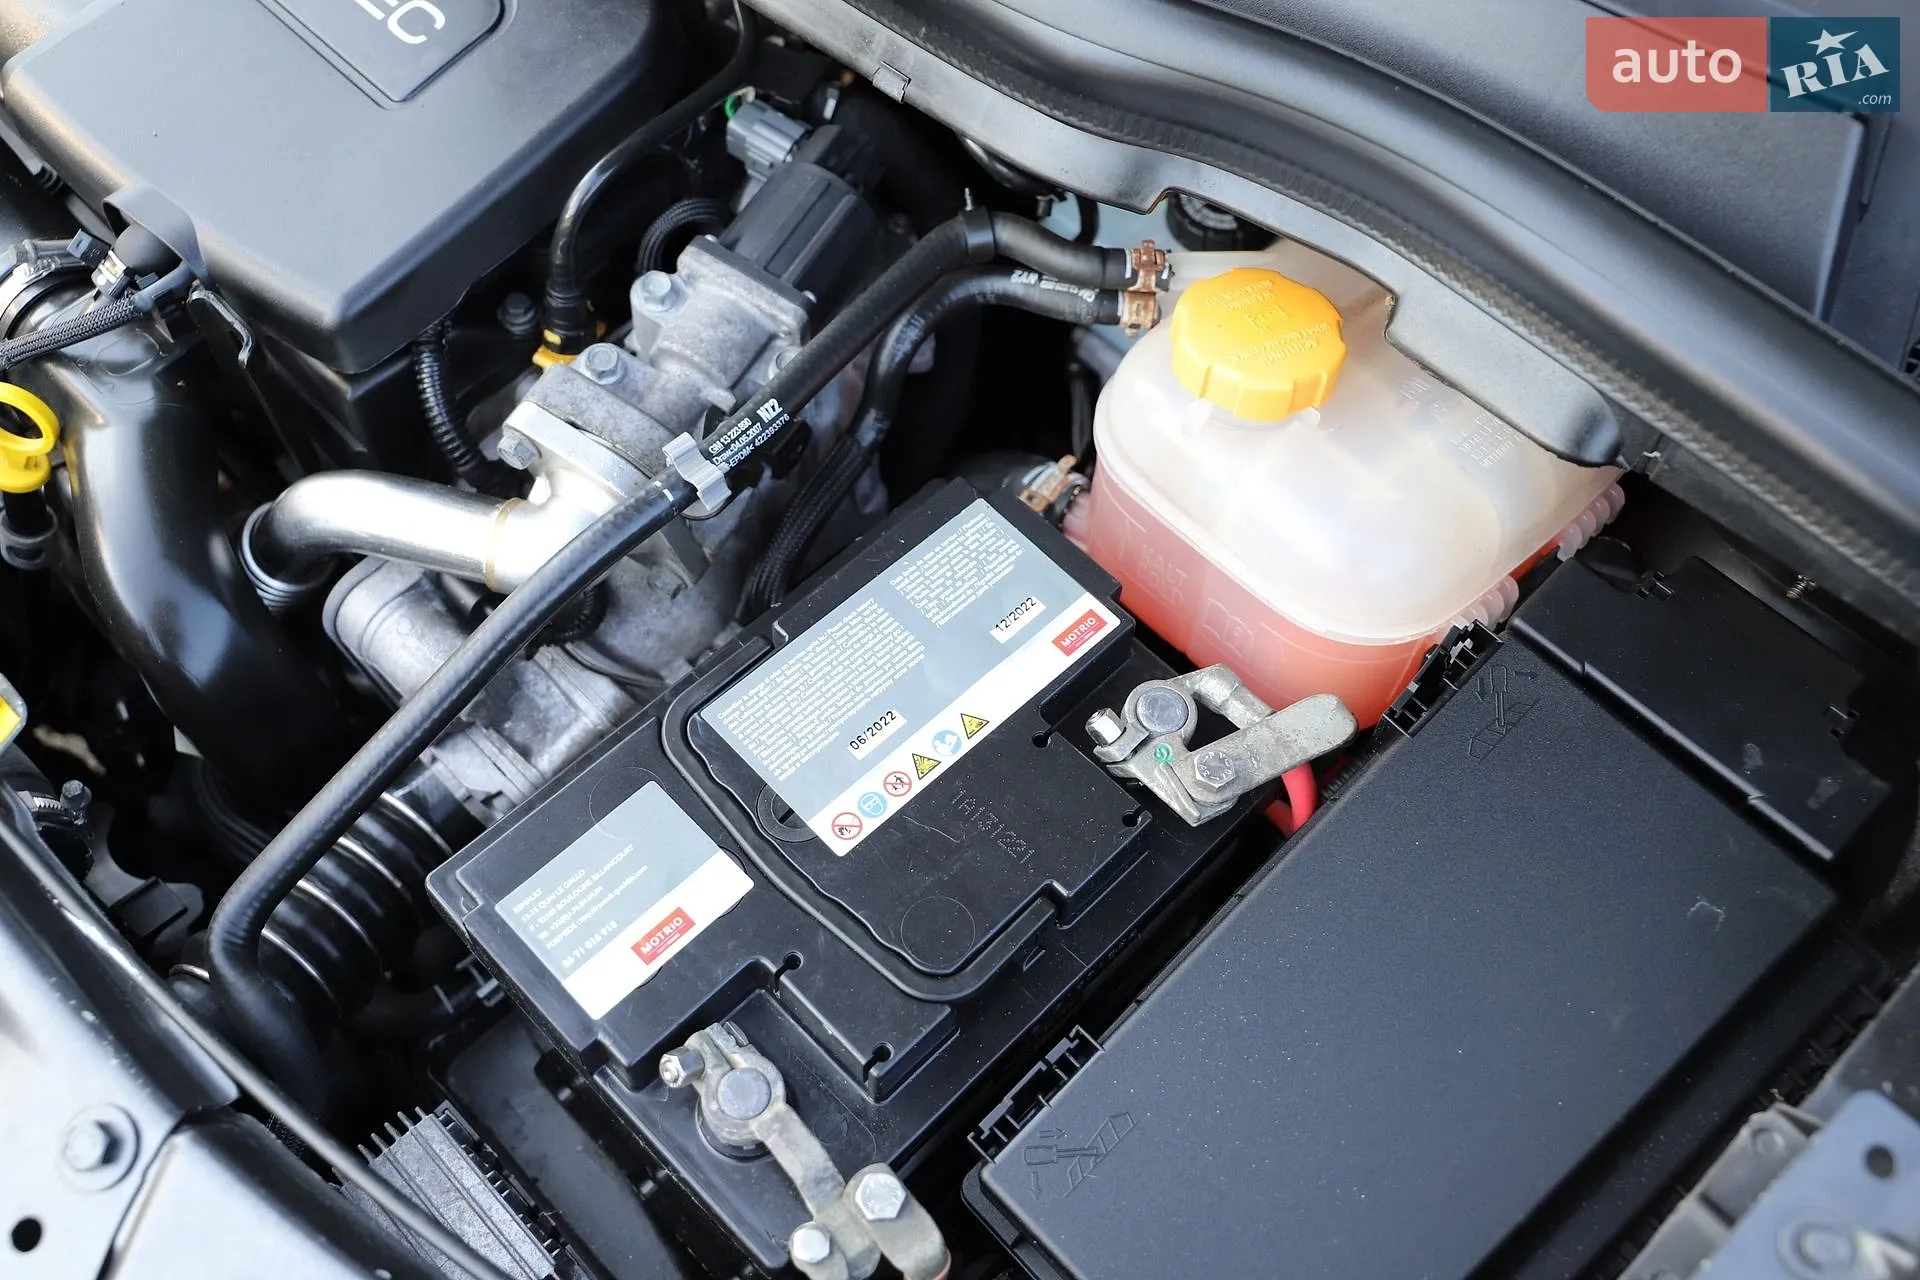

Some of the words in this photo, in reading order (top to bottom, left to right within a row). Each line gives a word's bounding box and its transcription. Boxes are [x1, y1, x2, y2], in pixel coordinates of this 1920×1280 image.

[756, 398, 783, 423] NZ2
[708, 440, 725, 456] GM
[995, 597, 1037, 632] 12/2022
[1060, 616, 1096, 647] MOTRIO
[849, 710, 897, 750] 06/2022
[639, 916, 684, 955] MOTRIO
